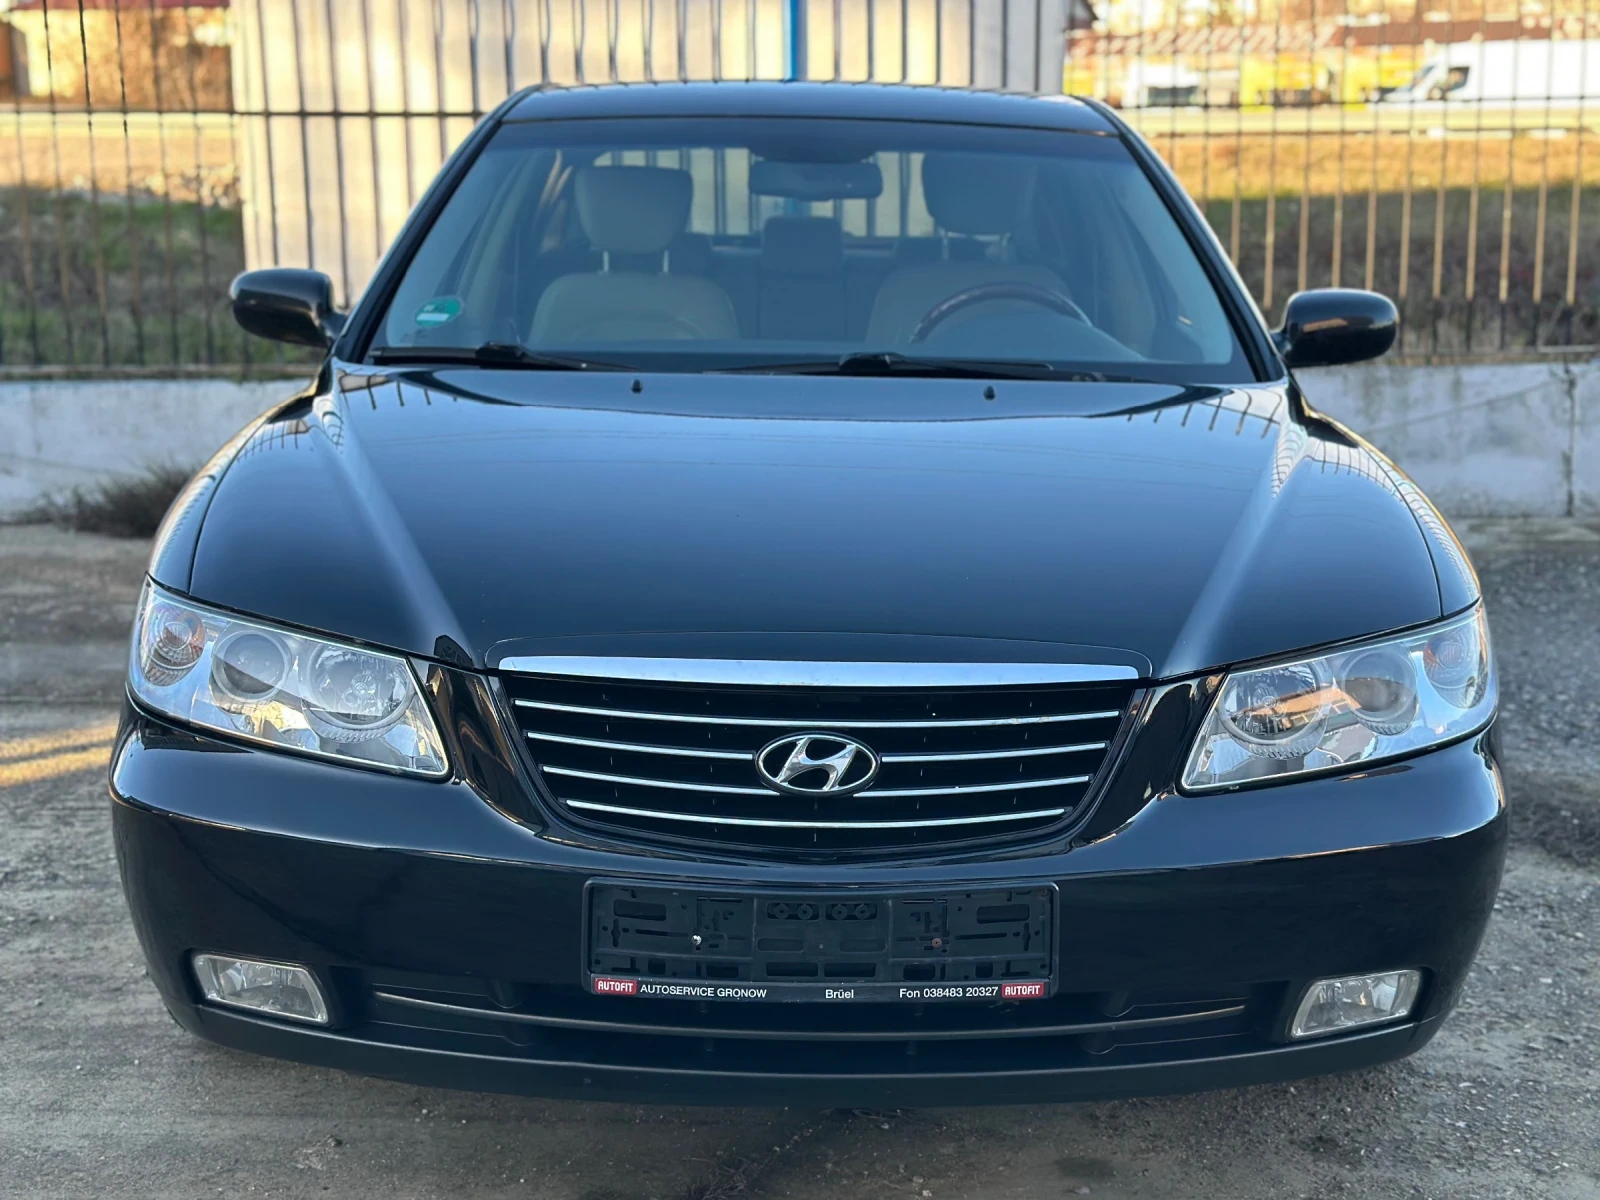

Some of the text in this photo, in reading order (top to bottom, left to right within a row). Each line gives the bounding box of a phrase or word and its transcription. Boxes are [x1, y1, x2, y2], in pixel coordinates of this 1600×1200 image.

[597, 980, 634, 993] AUTOFIT
[640, 984, 767, 998] AUTOSERVICE GRONOW
[899, 986, 999, 998] Fon 038483 20327
[1004, 984, 1041, 995] AUTOFIT
[825, 988, 855, 999] Brüel
